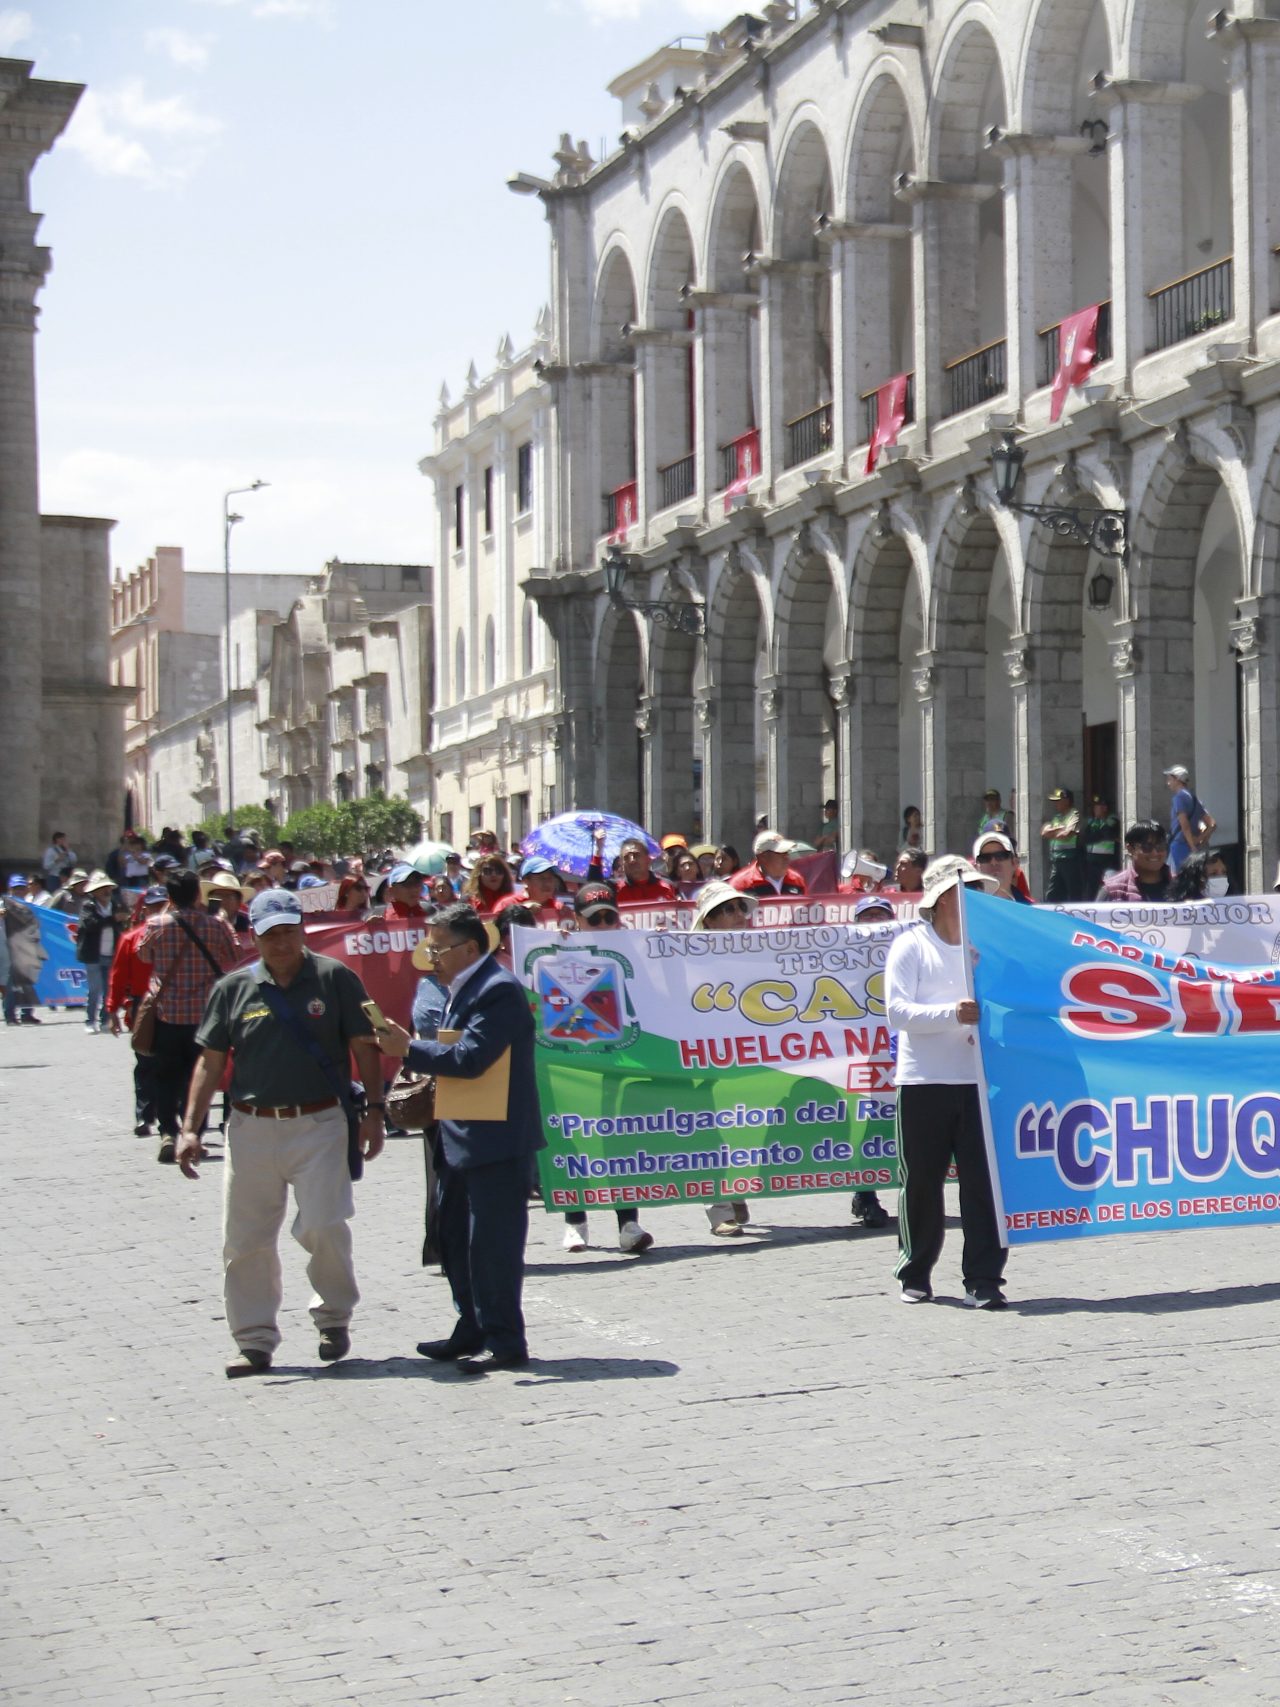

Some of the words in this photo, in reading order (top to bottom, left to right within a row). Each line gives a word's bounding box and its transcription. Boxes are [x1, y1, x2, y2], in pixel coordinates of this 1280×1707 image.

[1110, 902, 1273, 928] SUPERIOR
[647, 927, 839, 959] INSTITUTO
[846, 923, 896, 945] DE
[776, 944, 889, 976] TECNO
[1152, 952, 1198, 979] LA
[679, 1030, 834, 1069] HUELGA
[844, 1026, 892, 1058] NA
[851, 1065, 897, 1090] EX
[795, 1099, 847, 1124] del
[857, 1098, 897, 1122] Re
[811, 1137, 853, 1163] de
[862, 1135, 897, 1161] do
[552, 1189, 578, 1205] EN
[583, 1182, 678, 1204] DEFENSA
[686, 1180, 715, 1198] DE
[720, 1176, 764, 1195] LOS
[770, 1168, 893, 1192] DERECHOS
[1097, 1203, 1126, 1222] DE
[1131, 1200, 1172, 1220] LOS
